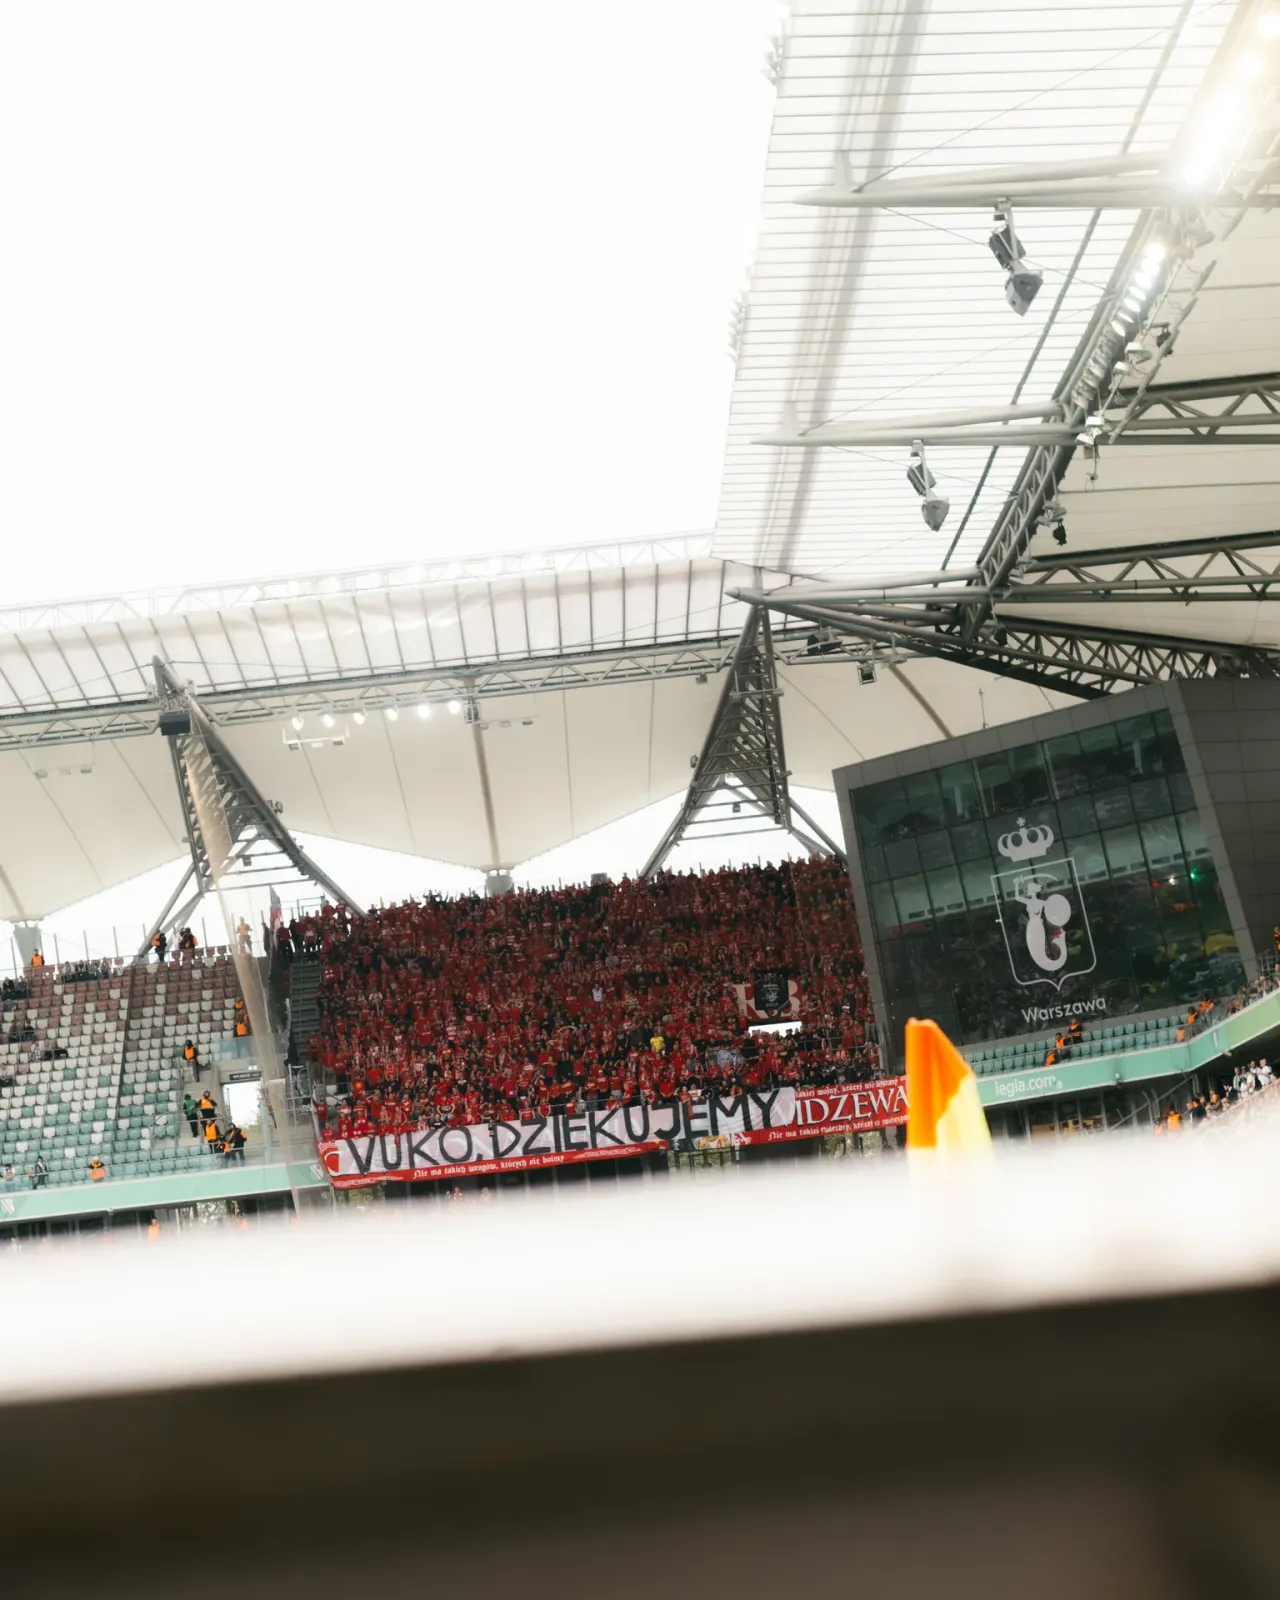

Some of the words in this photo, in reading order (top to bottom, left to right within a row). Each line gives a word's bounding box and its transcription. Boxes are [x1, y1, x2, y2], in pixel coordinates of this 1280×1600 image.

[1021, 997, 1107, 1023] Warszawa
[995, 1075, 1056, 1098] legia.com
[768, 1131, 783, 1141] Nie
[412, 1169, 428, 1180] Nie
[430, 1169, 442, 1177] ma
[444, 1166, 466, 1175] takich
[500, 1160, 527, 1170] których
[543, 1154, 565, 1164] boimy
